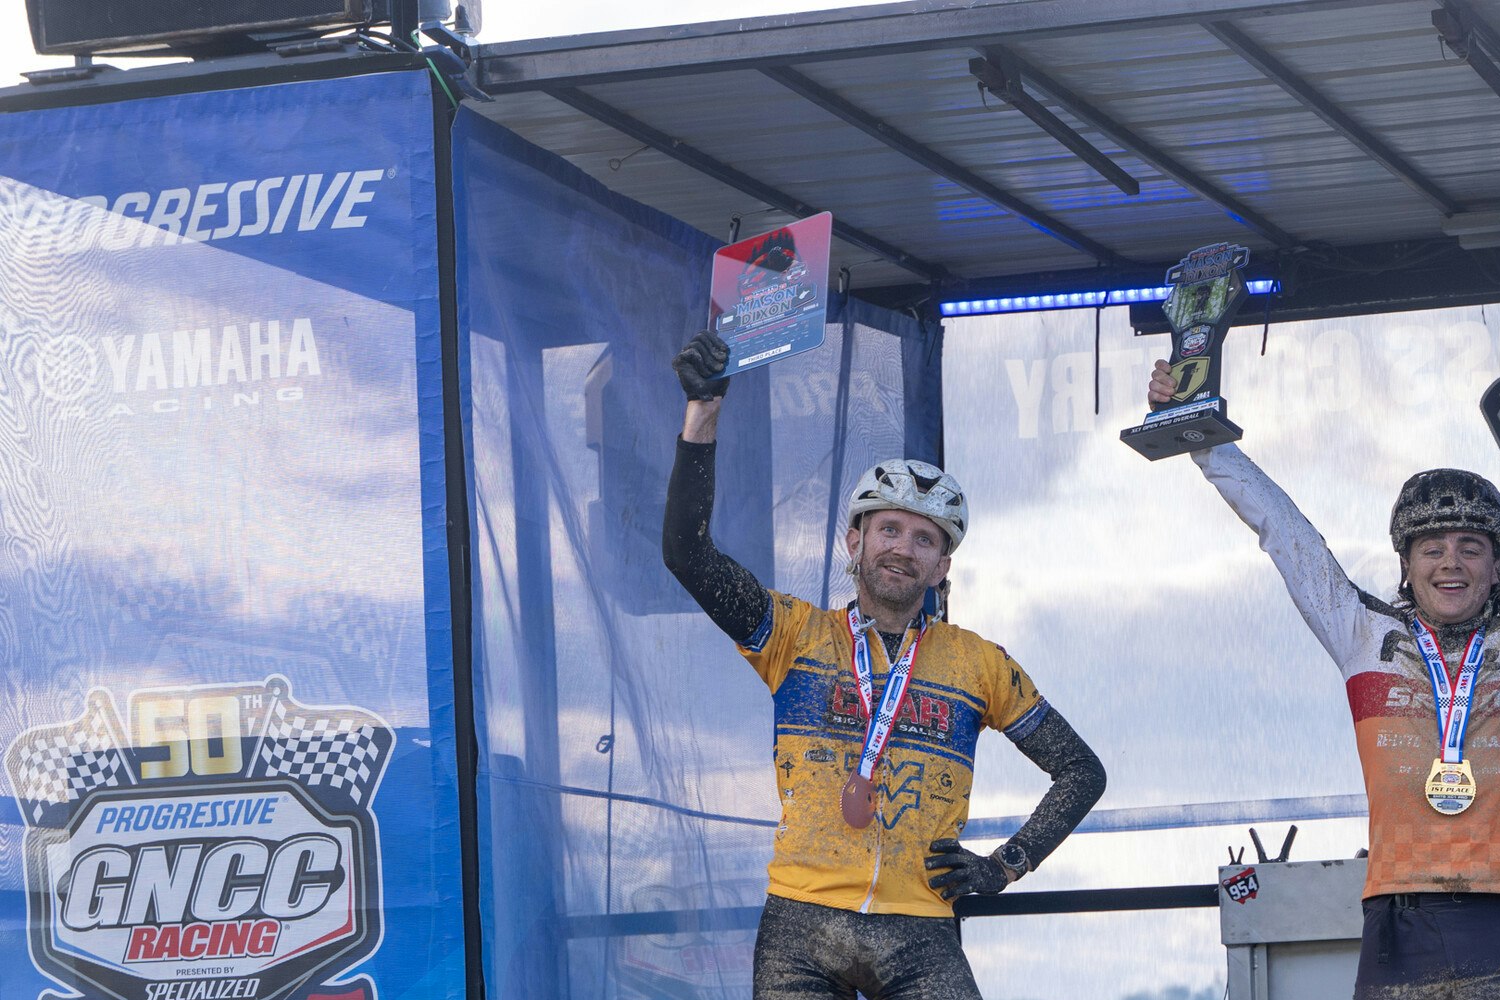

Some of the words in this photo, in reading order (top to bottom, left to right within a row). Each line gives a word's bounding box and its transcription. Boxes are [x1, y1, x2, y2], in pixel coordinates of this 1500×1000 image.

[737, 286, 798, 317] MASON
[741, 301, 792, 326] DIXON
[103, 318, 321, 393] YAMAHA
[832, 684, 949, 732] GAR
[140, 697, 243, 779] 50
[97, 797, 280, 834] PROGRESSIVE
[63, 836, 340, 930] GNCC
[1229, 876, 1257, 900] 954
[126, 921, 279, 961] RACING
[176, 968, 215, 977] PRESENTED
[217, 967, 234, 976] BY
